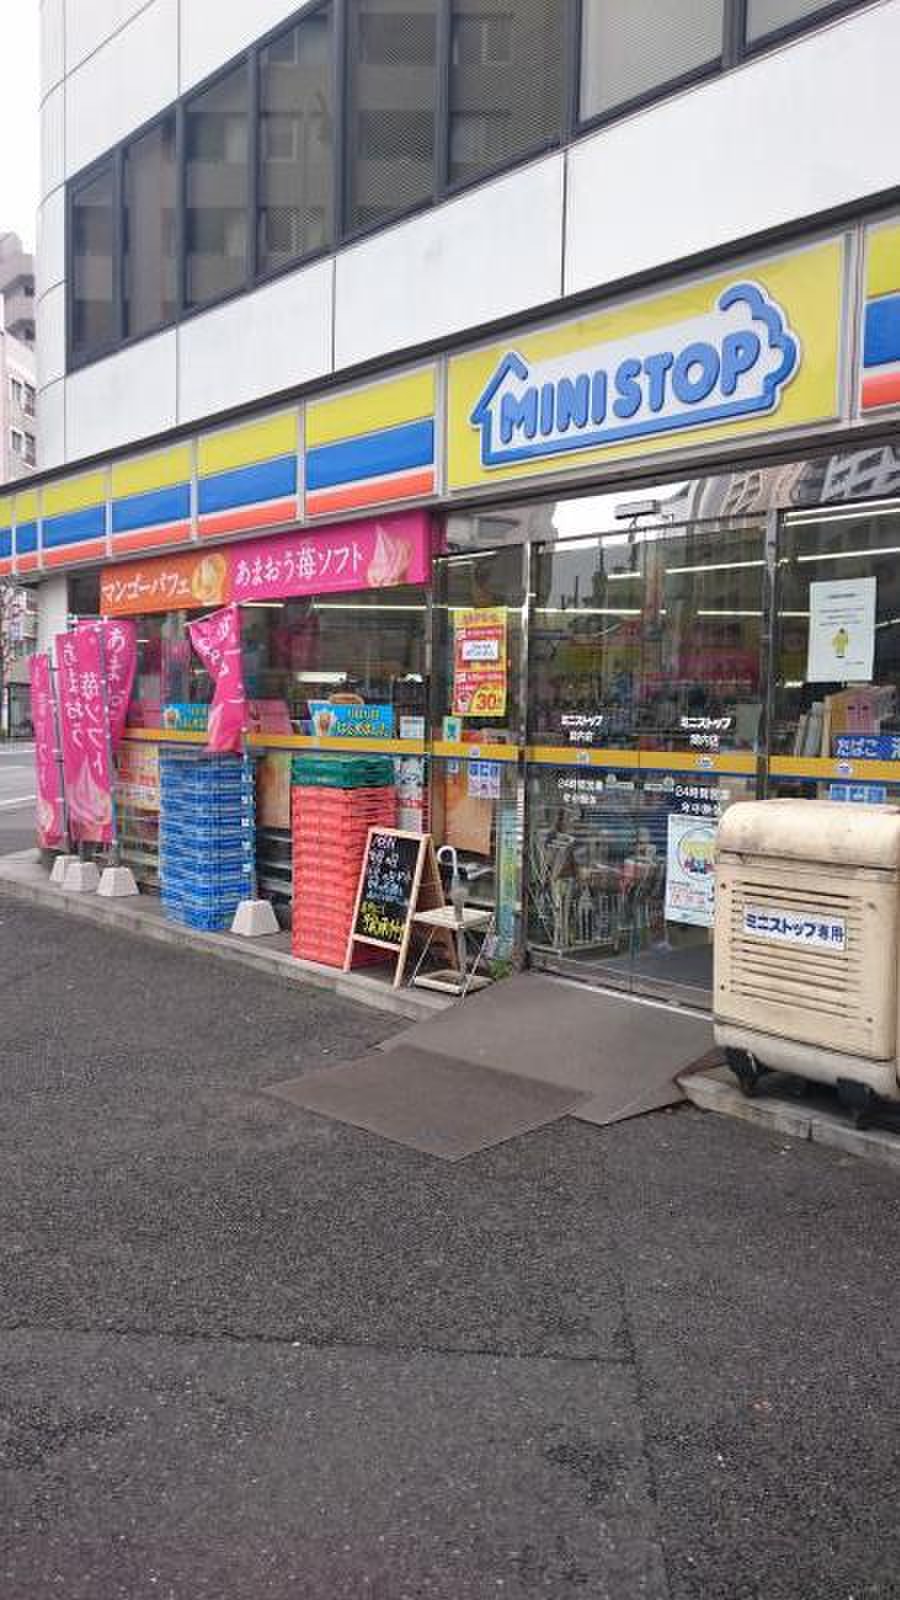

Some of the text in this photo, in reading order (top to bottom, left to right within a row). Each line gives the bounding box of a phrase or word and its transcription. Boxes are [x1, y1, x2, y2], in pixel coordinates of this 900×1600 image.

[235, 541, 363, 586] あまおう苺ソフト
[102, 572, 192, 602] マンゴーパフェ
[837, 737, 878, 757] たばこ
[745, 913, 844, 943] ミニストップ専用
